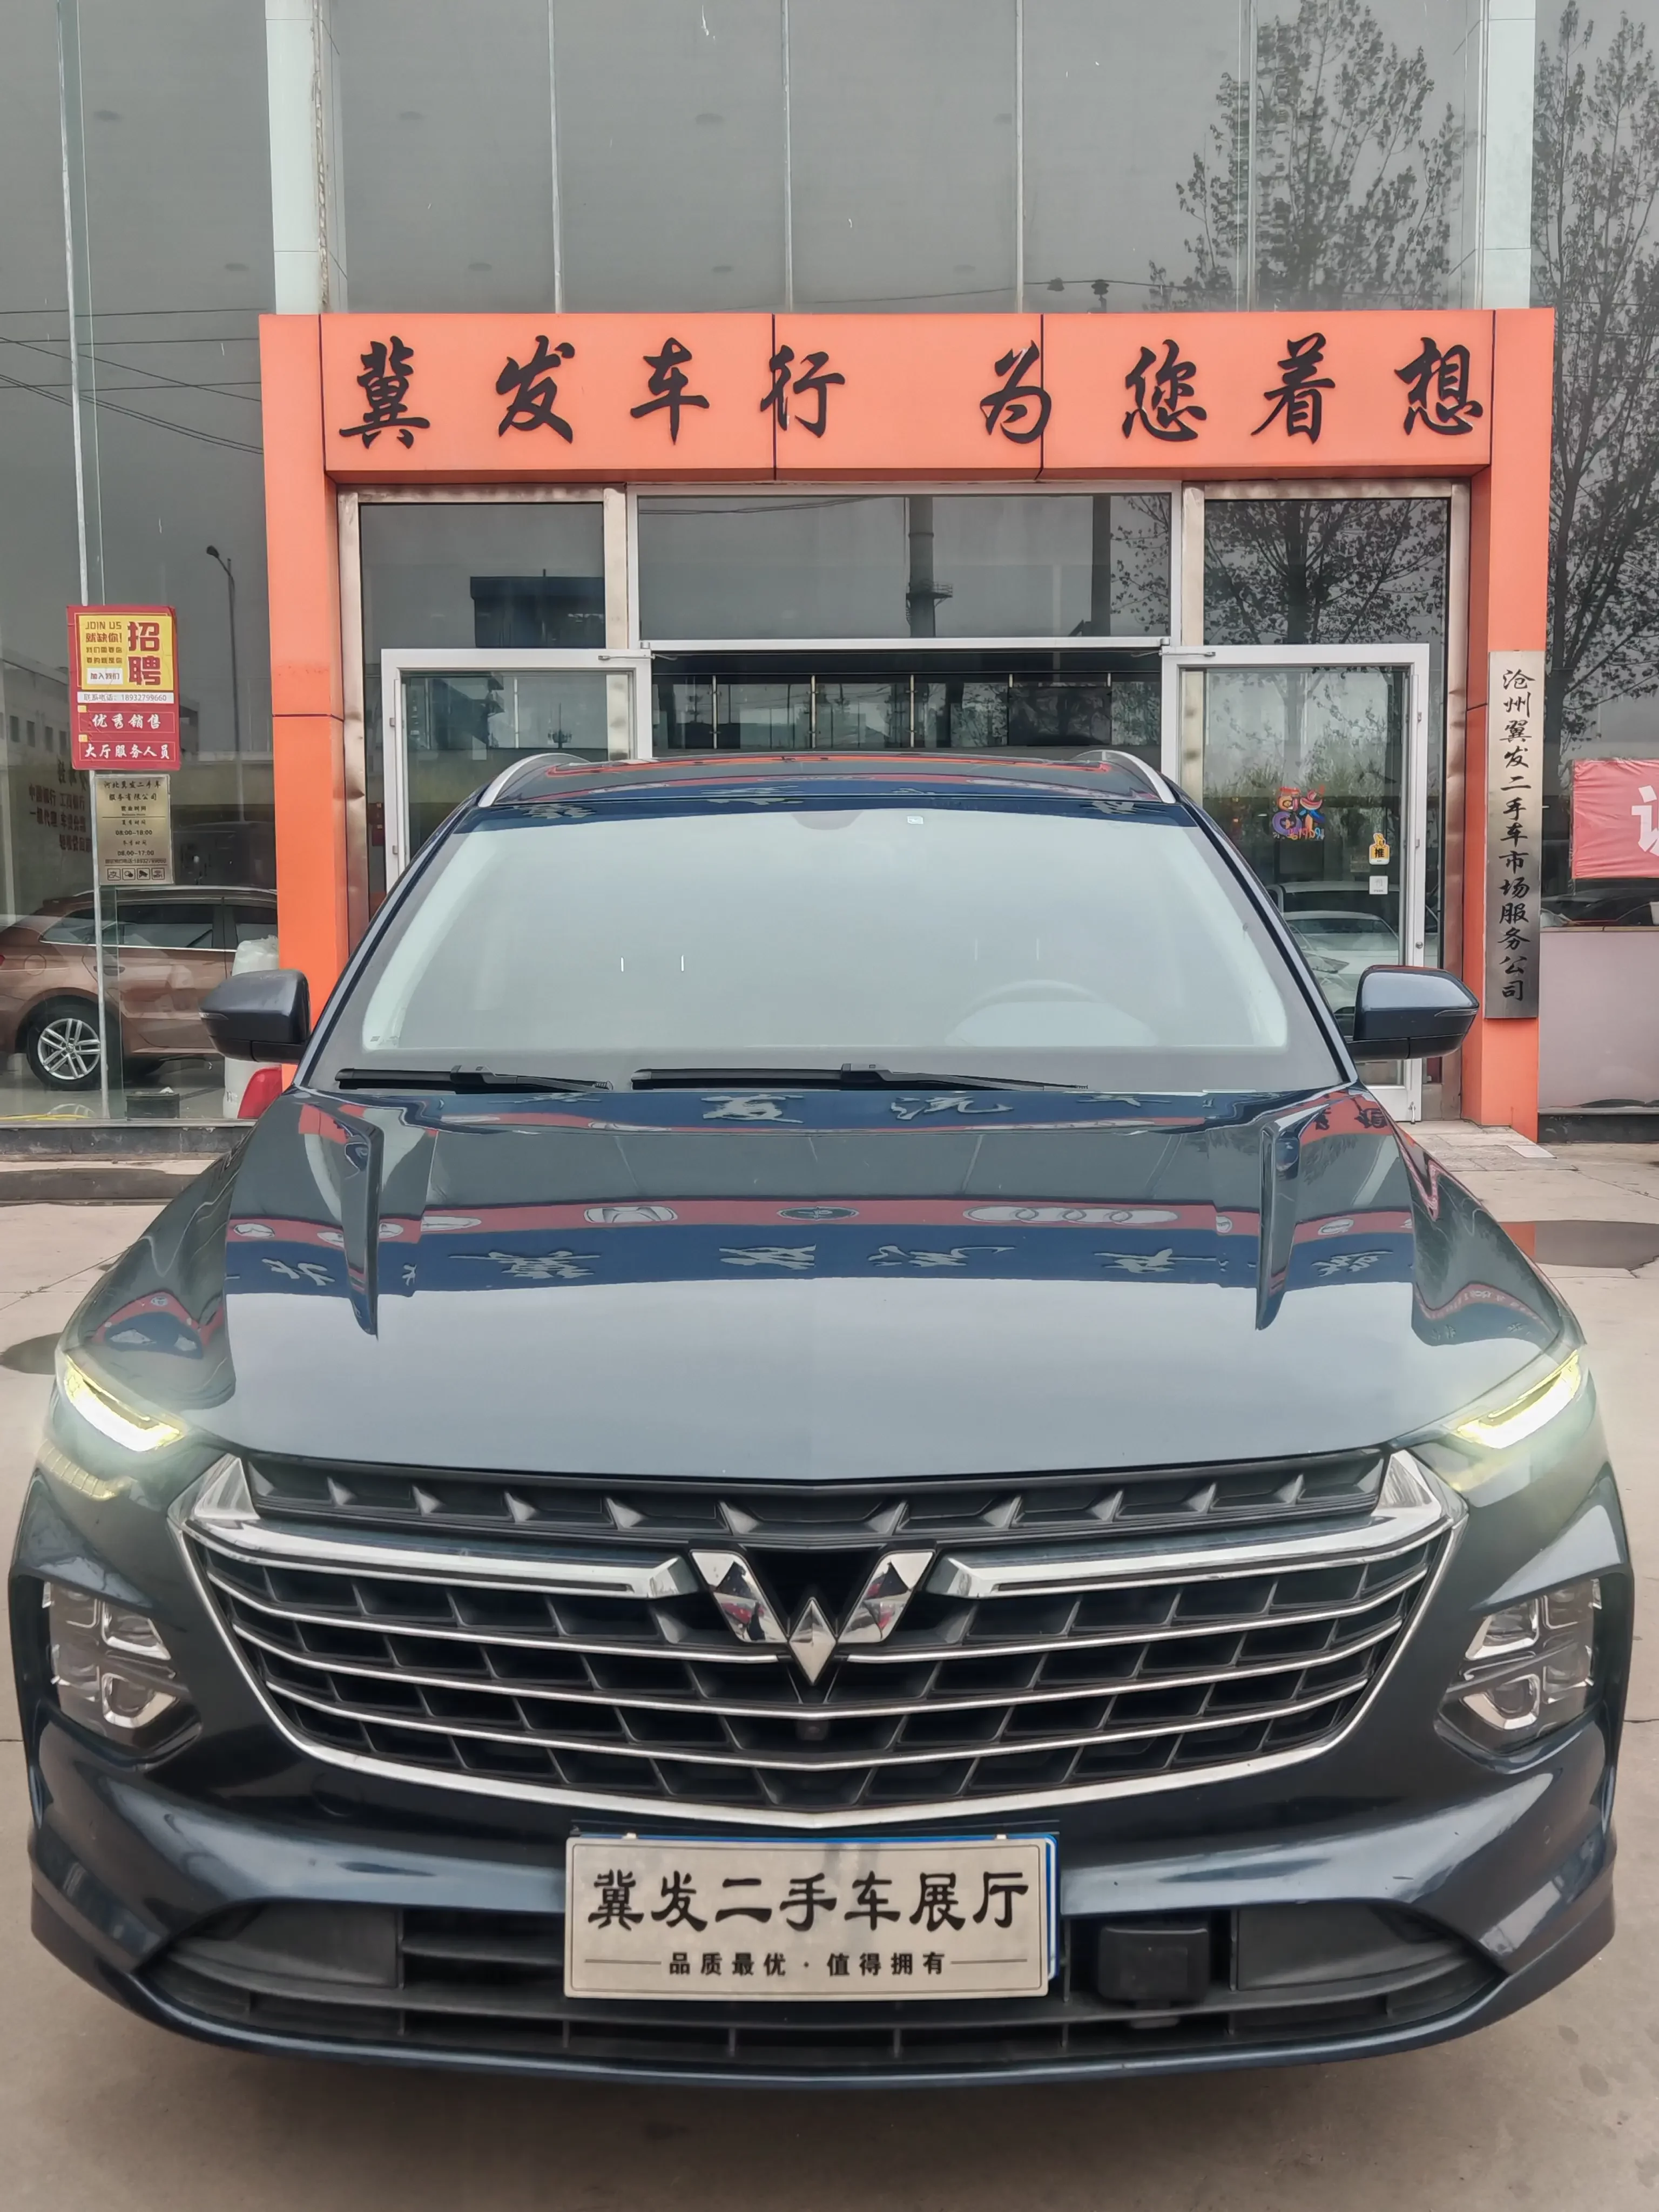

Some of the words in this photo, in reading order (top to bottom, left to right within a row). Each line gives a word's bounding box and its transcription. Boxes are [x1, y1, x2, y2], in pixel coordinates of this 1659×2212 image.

[339, 335, 845, 449] 冀发车行
[980, 332, 1483, 444] 为您着想
[85, 622, 105, 630] JOIN
[109, 621, 122, 630] US
[127, 621, 161, 685] 招聘
[92, 713, 161, 729] 优秀销售
[84, 743, 170, 759] 大厅服务人员
[1374, 847, 1385, 858] 推
[587, 1868, 1029, 1932] 冀发二手车展厅
